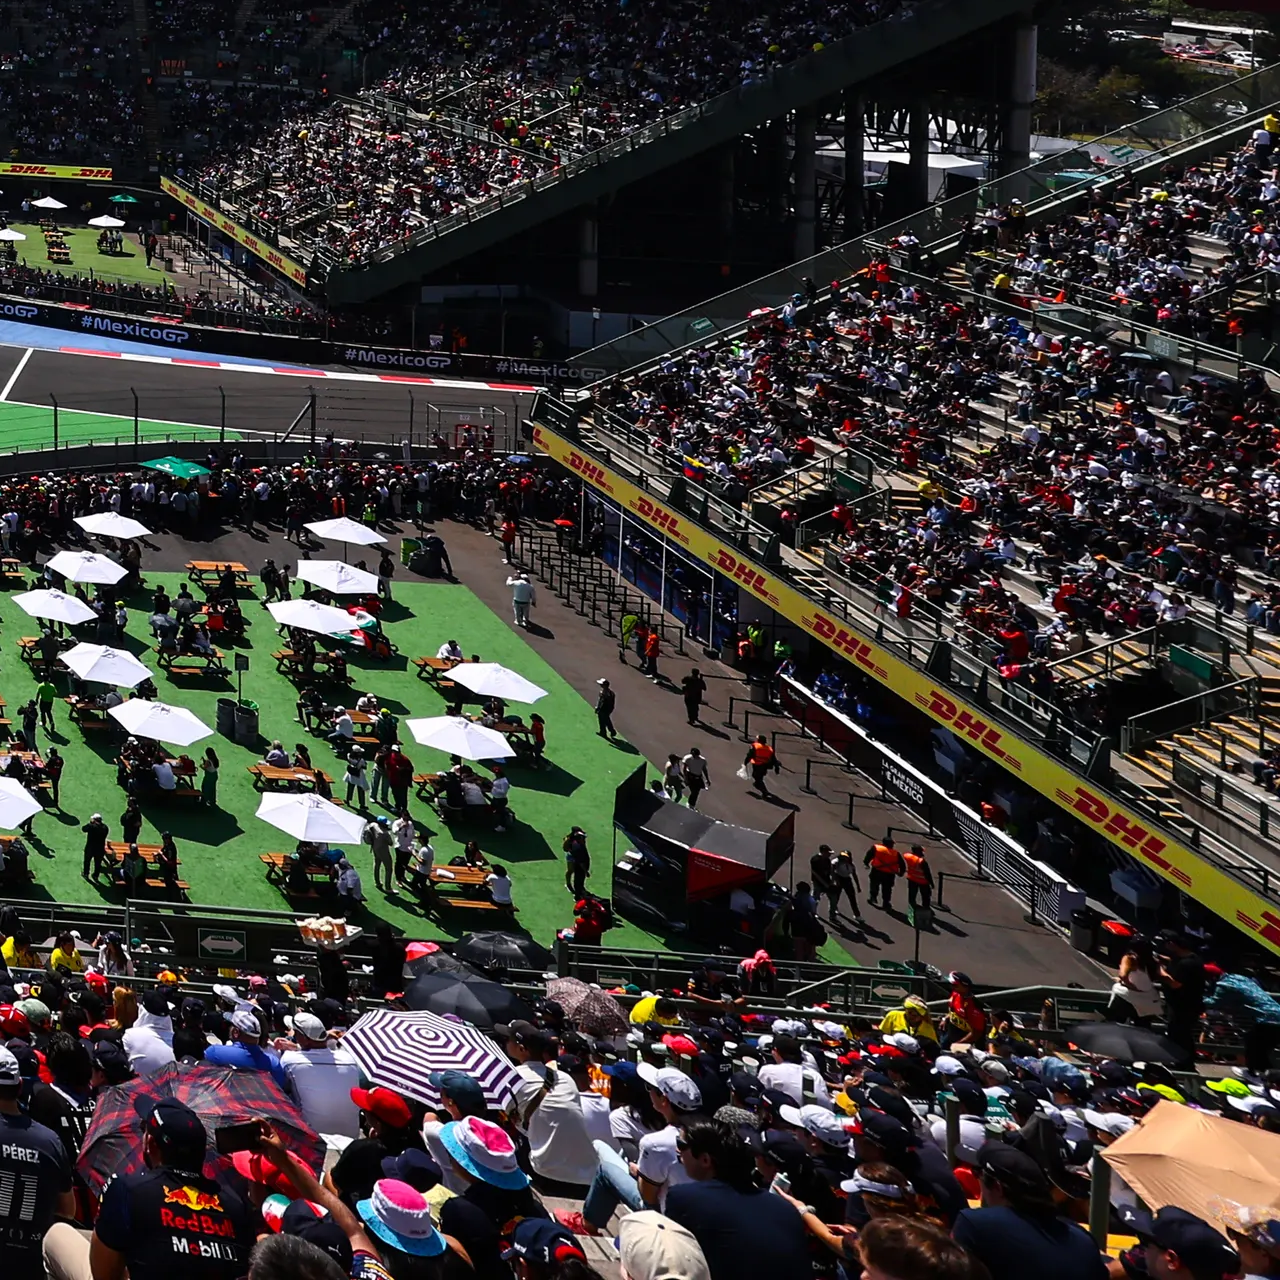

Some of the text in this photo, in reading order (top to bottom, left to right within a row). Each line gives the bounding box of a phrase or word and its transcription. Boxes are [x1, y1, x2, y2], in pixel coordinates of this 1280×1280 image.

[9, 164, 48, 175] DHL
[81, 314, 189, 344] #MexicoGP
[345, 347, 451, 369] #MexicoGP
[570, 452, 608, 489] DHL
[638, 496, 682, 537] DHL
[717, 549, 771, 599] DHL
[813, 613, 879, 670] DHL
[928, 690, 1007, 758] DHL
[882, 758, 924, 795] LA GRAN FIESTA
[892, 776, 923, 804] MEXICO
[1073, 787, 1171, 871] DHL
[2, 1143, 40, 1163] PÉREZ
[160, 1207, 235, 1239] Red Bull
[171, 1236, 221, 1259] Mobil
